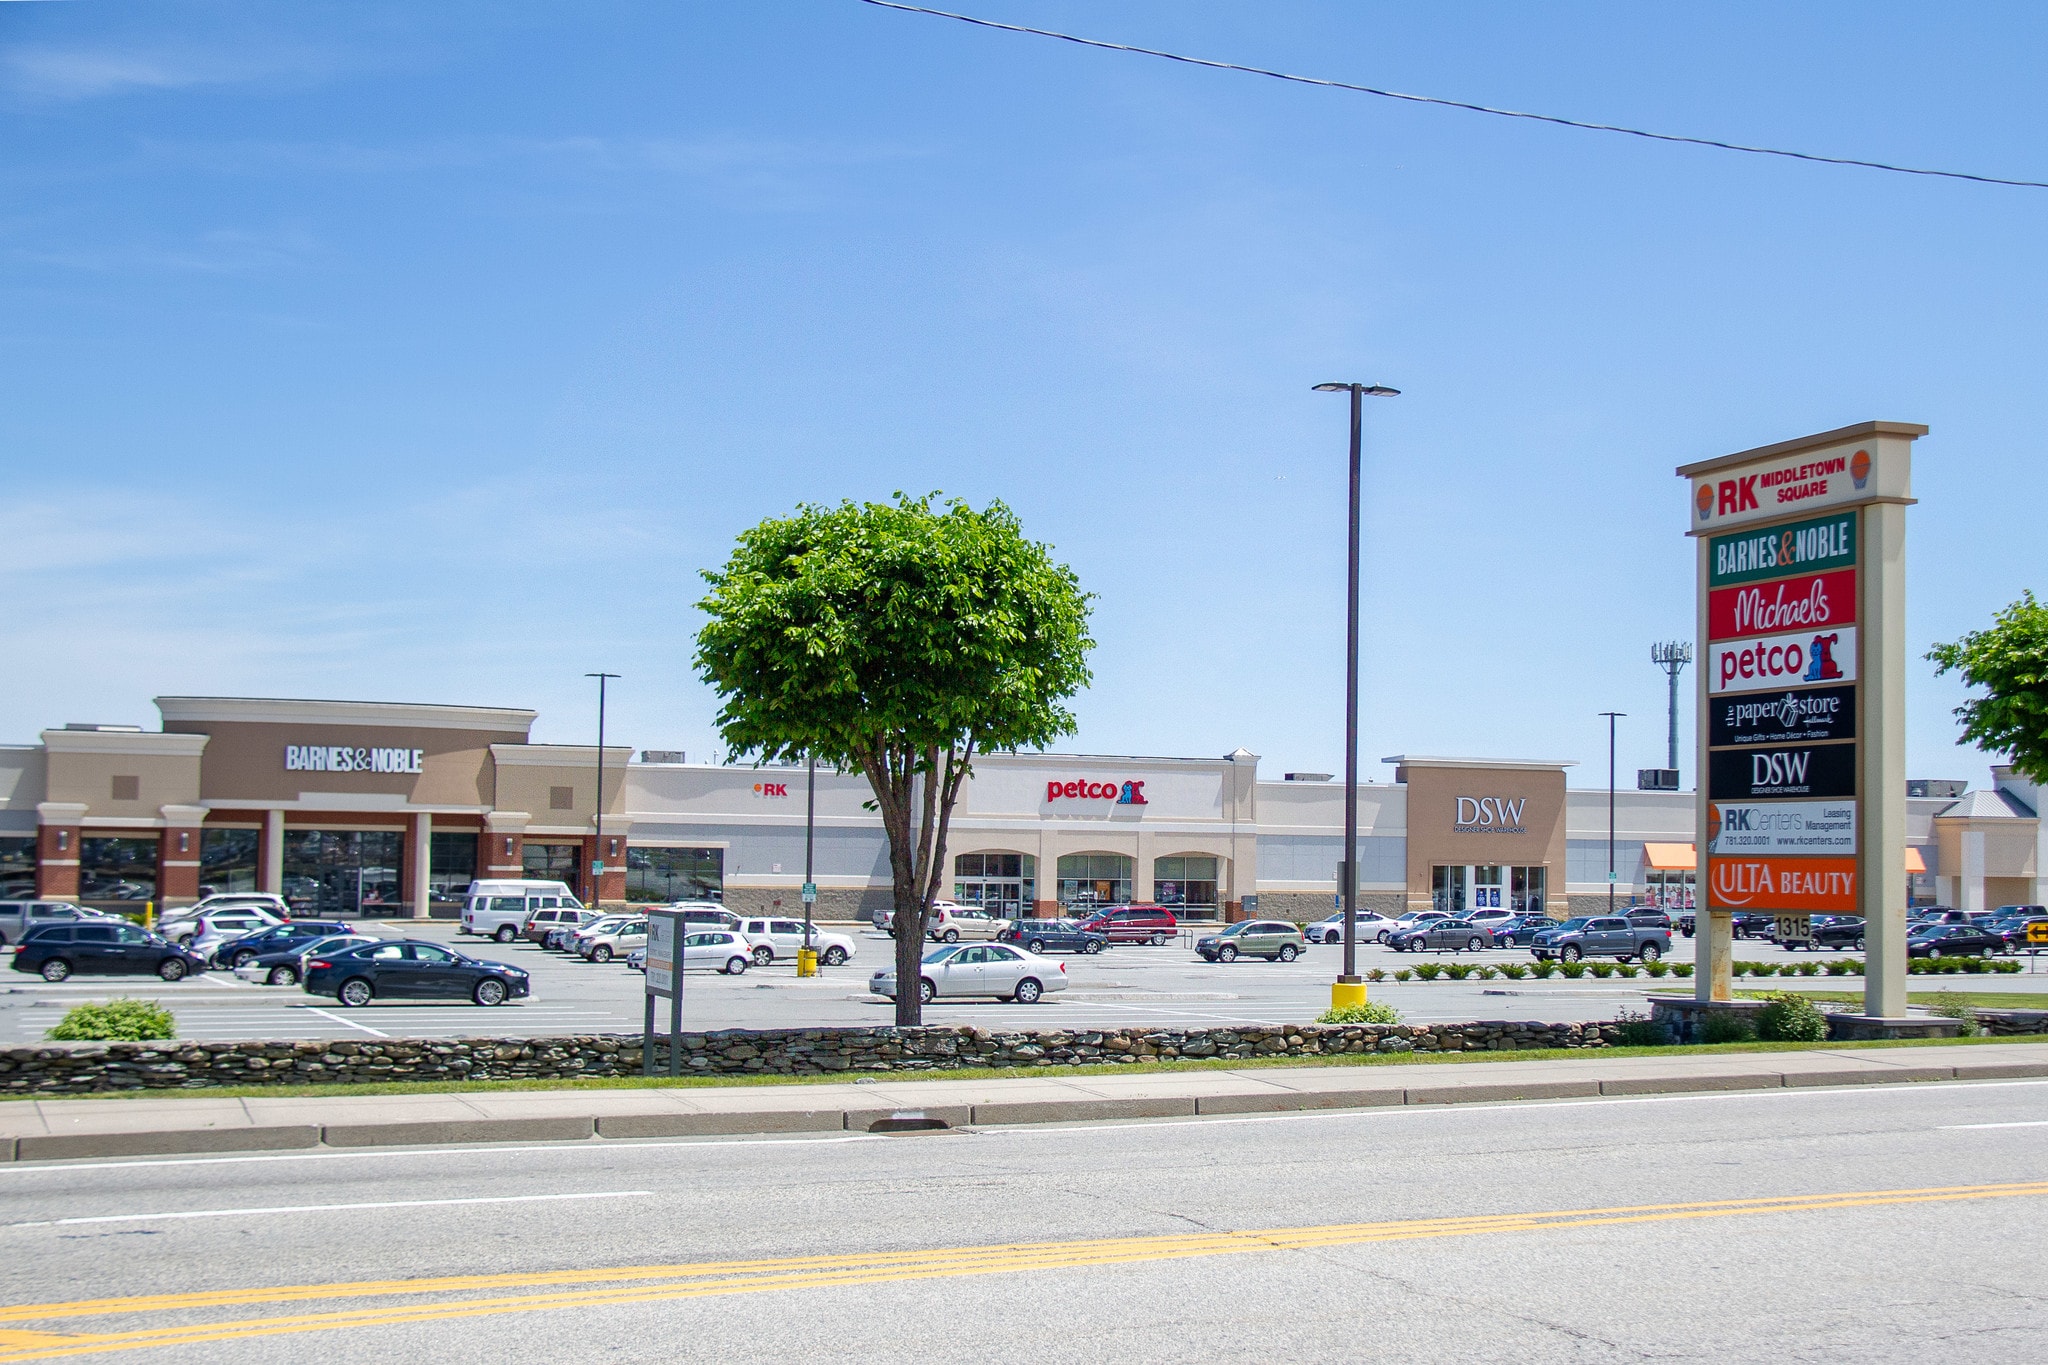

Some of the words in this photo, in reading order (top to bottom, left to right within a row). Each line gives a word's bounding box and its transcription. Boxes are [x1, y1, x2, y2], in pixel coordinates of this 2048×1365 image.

[1718, 474, 1759, 516] RK
[1760, 456, 1846, 489] MIDDLETOWN
[1777, 479, 1828, 503] SQUARE
[1734, 578, 1831, 632] Michaels
[1721, 641, 1803, 690] petco
[1736, 702, 1778, 727] paper
[1799, 695, 1840, 715] store
[1734, 735, 1752, 743] Unique
[1753, 733, 1766, 741] Gifts
[1769, 732, 1785, 740] Home
[1807, 730, 1829, 738] Fashion
[1752, 751, 1811, 786] DSW
[763, 783, 788, 797] RK
[1047, 779, 1118, 803] petco
[1456, 796, 1527, 826] DSW
[1823, 808, 1851, 819] Leasing
[1805, 820, 1851, 832] Management
[1725, 836, 1770, 846] 781.320.0001
[1777, 836, 1851, 846] www.rkcenters.com
[1719, 863, 1775, 893] ULTA
[1780, 871, 1853, 895] BEAUTY
[1775, 916, 1810, 937] 1315
